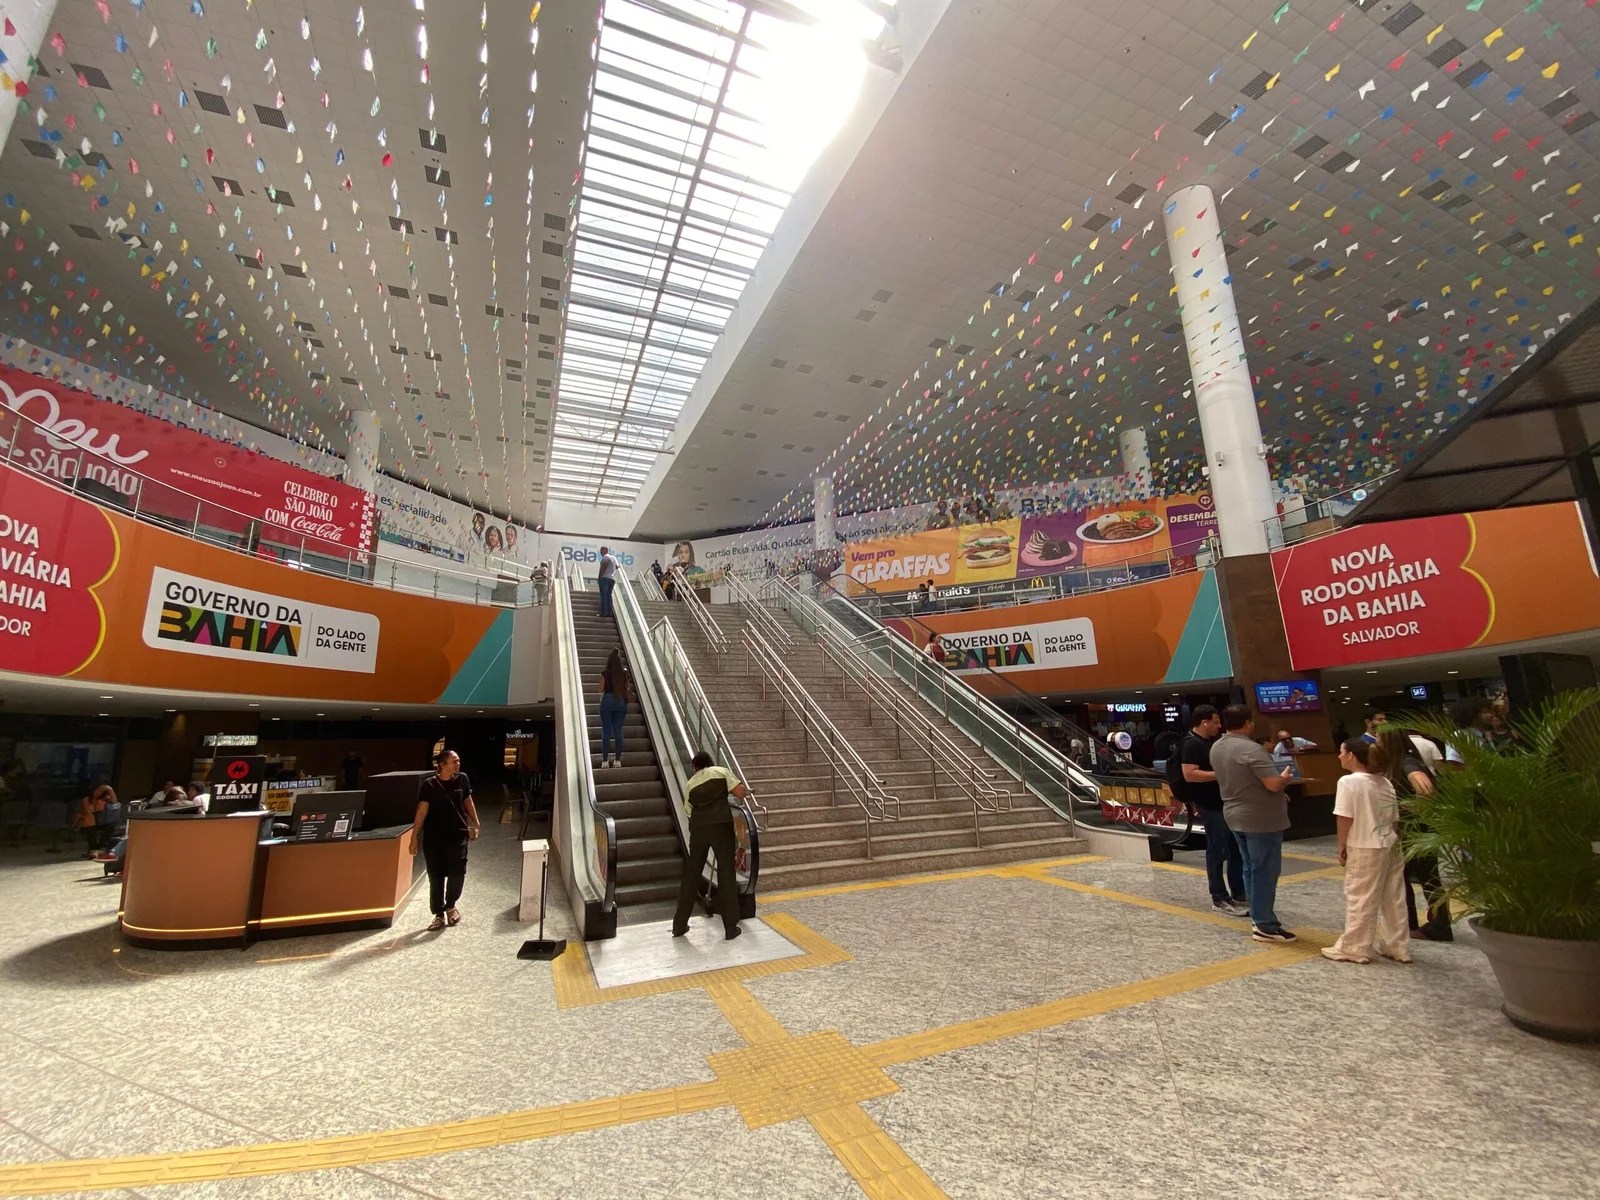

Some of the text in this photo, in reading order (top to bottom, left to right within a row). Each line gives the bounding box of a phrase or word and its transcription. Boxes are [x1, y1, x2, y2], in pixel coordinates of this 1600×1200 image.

[27, 447, 79, 479] SÃO
[170, 467, 262, 498] www.meusaojoao.com.br
[284, 480, 338, 508] CELEBRE O
[284, 496, 333, 522] SÃO JOÃO
[380, 496, 448, 526] especialidade
[264, 507, 346, 542] COM Coca-Cola
[705, 548, 731, 559] Cartão
[771, 536, 814, 550] Qualidade
[851, 548, 896, 562] Vem pro
[1330, 543, 1394, 575] NOVA
[1300, 557, 1441, 606] RODOVIÁRIA
[165, 581, 303, 625] GOVERNO DA
[1322, 590, 1427, 627] DA BAHIA
[315, 638, 367, 653] DA GENTE
[317, 626, 366, 641] DO LADO
[943, 631, 1032, 649] GOVERNO DA
[1044, 633, 1084, 646] DO LADO
[1342, 621, 1421, 646] SALVADOR
[1045, 642, 1086, 654] DA GENTE
[214, 780, 258, 795] TÁXI
